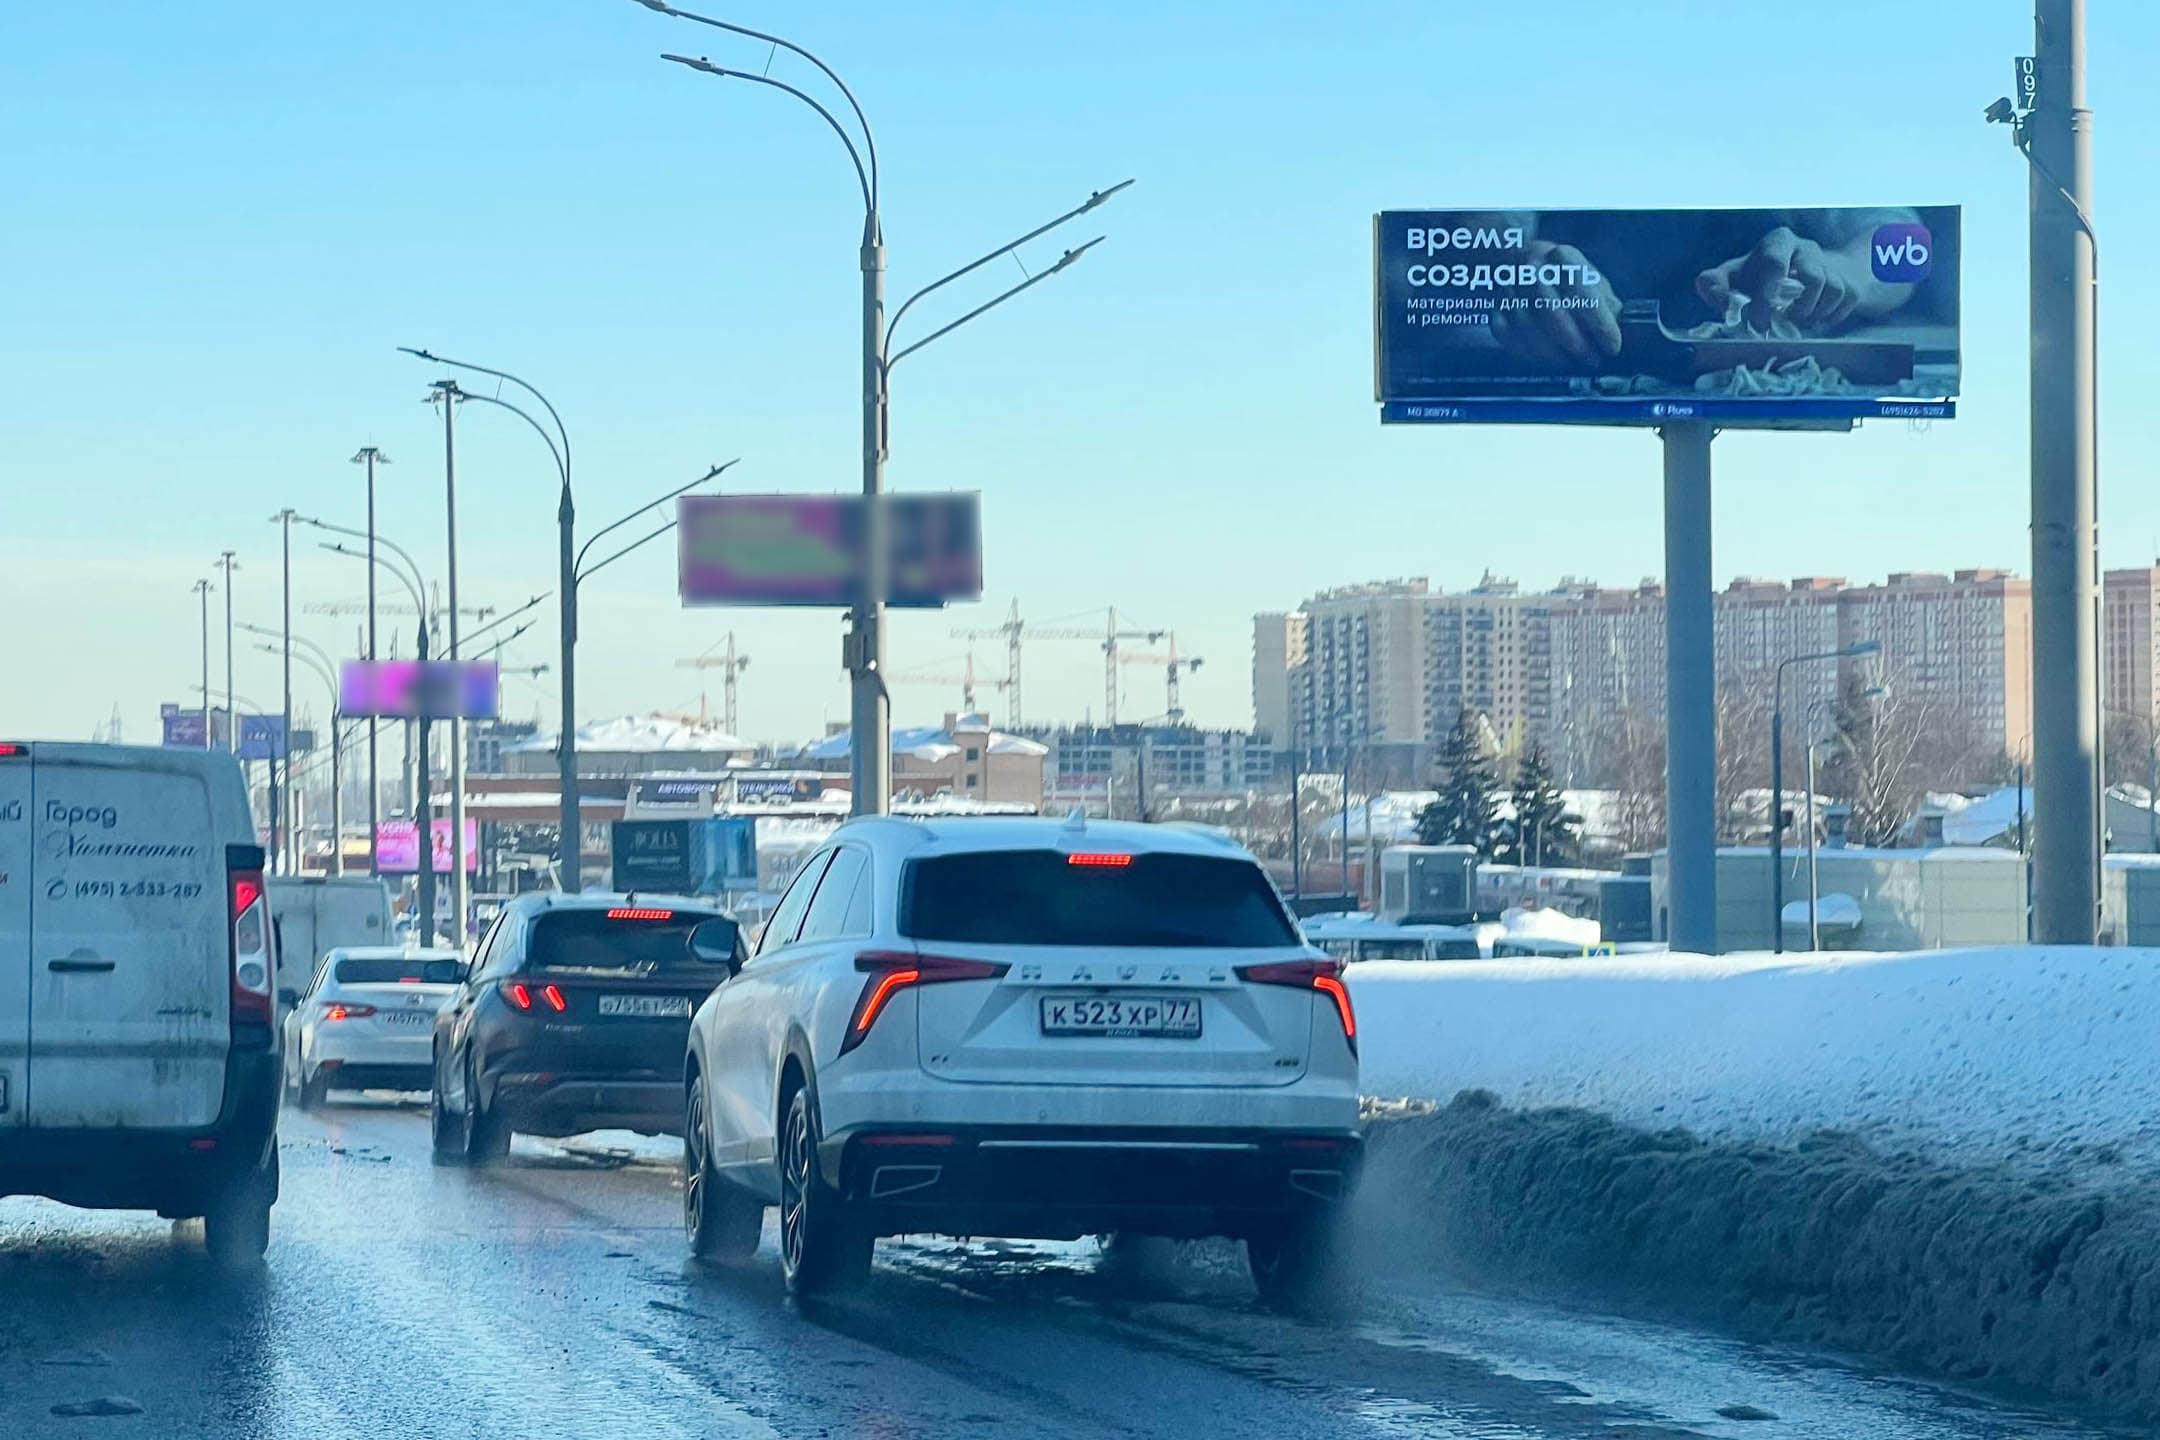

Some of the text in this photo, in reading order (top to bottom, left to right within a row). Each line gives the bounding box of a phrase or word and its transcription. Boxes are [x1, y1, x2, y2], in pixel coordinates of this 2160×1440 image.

[2022, 58, 2036, 109] 097
[1407, 227, 1524, 257] время
[1876, 233, 1929, 266] wb
[1407, 263, 1601, 291] создавать
[1407, 295, 1599, 311] материалы для стройки
[1407, 314, 1489, 327] и ремонта
[46, 800, 117, 829] Город
[75, 880, 114, 899] (495)
[1073, 1002, 1122, 1025] 523
[1166, 1001, 1191, 1021] 77
